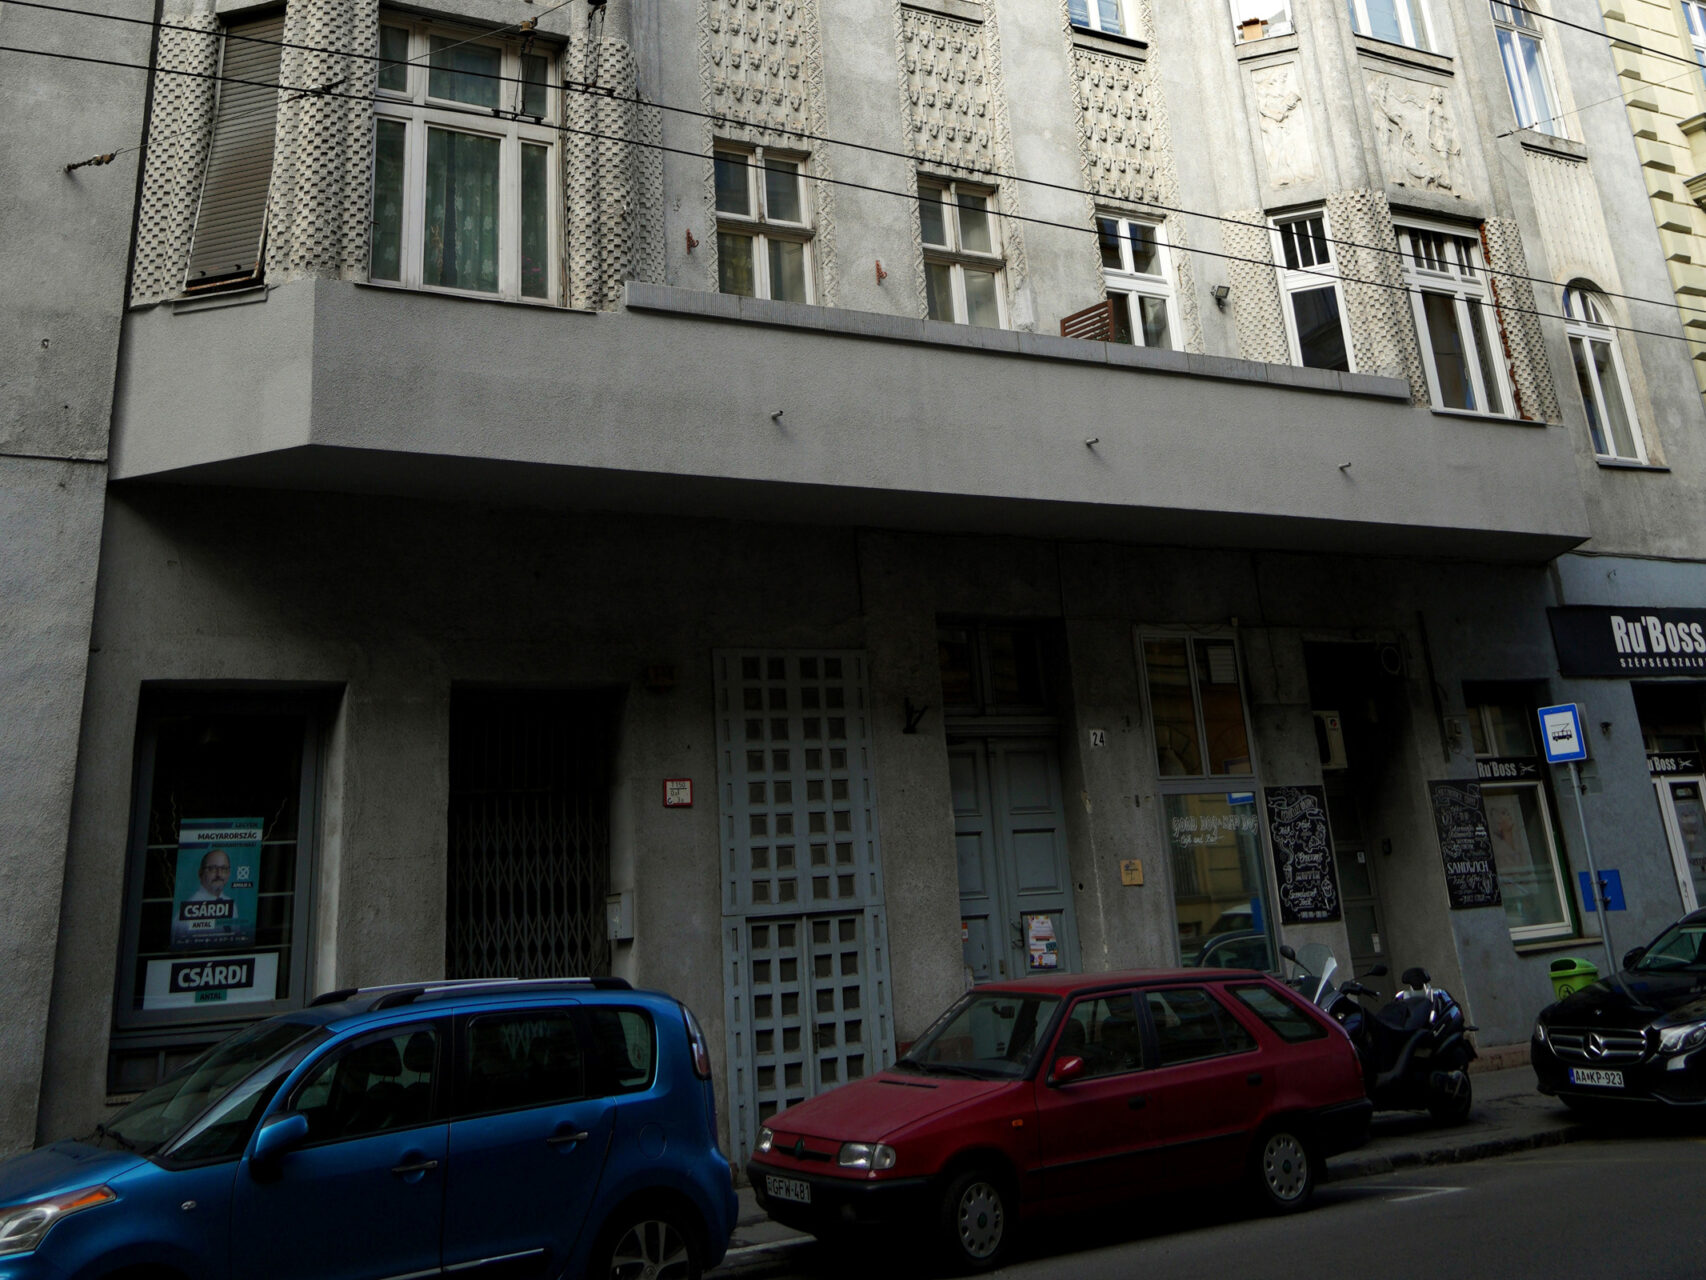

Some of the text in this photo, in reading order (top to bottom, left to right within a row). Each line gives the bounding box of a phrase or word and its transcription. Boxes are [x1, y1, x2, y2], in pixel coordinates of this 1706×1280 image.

[1610, 615, 1706, 653] Ru'Boss
[1620, 656, 1706, 668] SZÉPSÉGSZALO
[1092, 731, 1105, 746] 24
[1477, 761, 1518, 778] Ru'Boss
[197, 831, 257, 840] MAGYARORSZÁG
[1446, 861, 1489, 874] SANDWICH
[184, 902, 230, 918] CSÁRDI
[177, 962, 248, 988] CSÁRDI
[199, 992, 222, 1001] ANTAL
[773, 1178, 811, 1201] GFW-481
